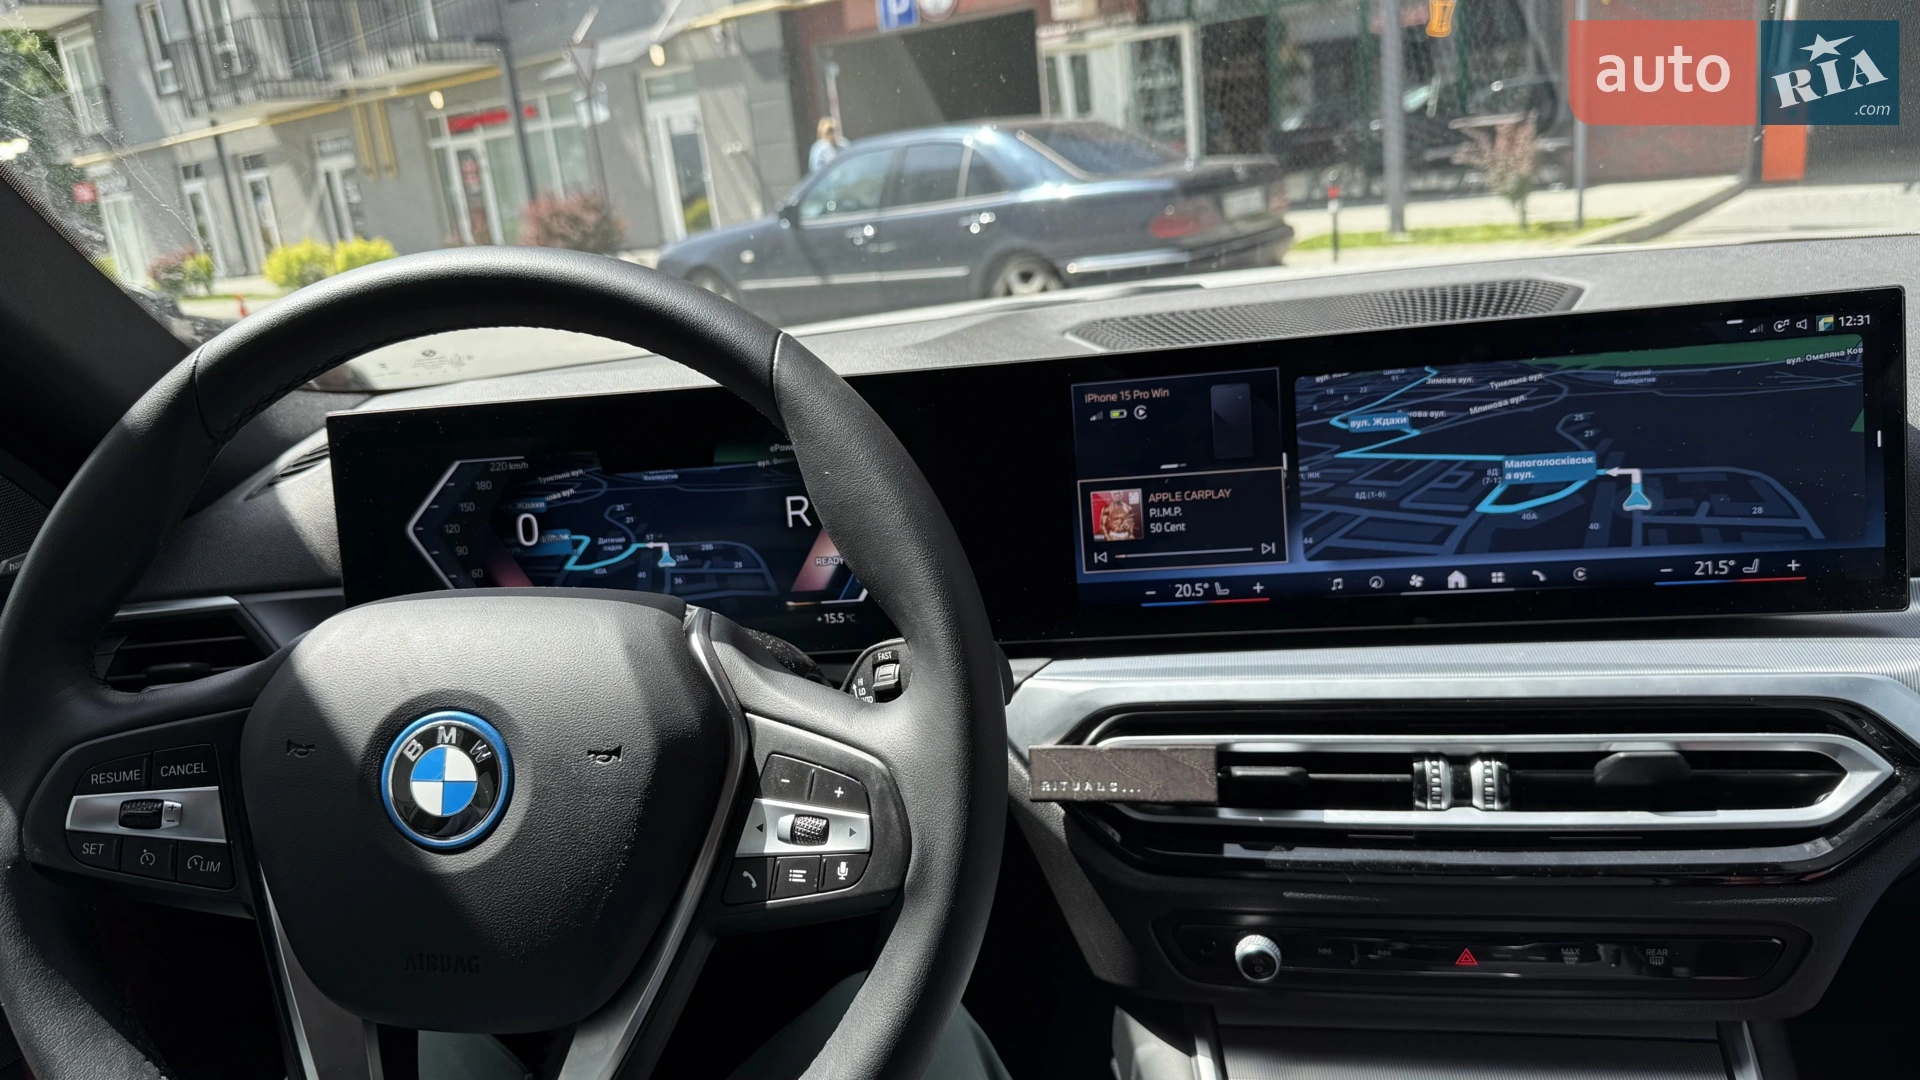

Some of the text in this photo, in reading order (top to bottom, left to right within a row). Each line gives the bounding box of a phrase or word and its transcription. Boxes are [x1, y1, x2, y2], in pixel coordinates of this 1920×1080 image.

[1838, 314, 1871, 327] 12:31
[1786, 355, 1803, 366] вул.
[1805, 350, 1845, 361] Омеляна
[1120, 390, 1132, 400] 15
[1133, 389, 1150, 399] Pro
[1151, 387, 1170, 398] Win
[1350, 416, 1408, 428] вул. Ждахи
[490, 461, 507, 472] 220
[1505, 455, 1593, 469] Малоголосківськ
[1513, 471, 1534, 482] вул.
[475, 481, 492, 491] 180
[1148, 488, 1232, 503] APPLE CARPLAY
[460, 502, 475, 512] 150
[785, 495, 812, 528] R
[1149, 506, 1183, 518] P.I.M.P.
[1751, 506, 1763, 514] 28
[444, 524, 461, 534] 120
[516, 512, 539, 546] 0
[1150, 521, 1186, 533] 50 Cent
[456, 546, 468, 556] 90
[1695, 559, 1735, 575] 21.5°
[471, 568, 484, 579] 60
[877, 651, 892, 660] FAST
[858, 687, 866, 695] LO
[403, 726, 492, 763] BMW
[160, 762, 207, 777] CANCEL
[91, 769, 141, 785] RESUME
[82, 843, 105, 855] SET
[199, 860, 221, 873] LIM
[1560, 947, 1580, 956] MAX
[1645, 948, 1668, 957] REAR
[404, 952, 480, 974] AIRBAG
